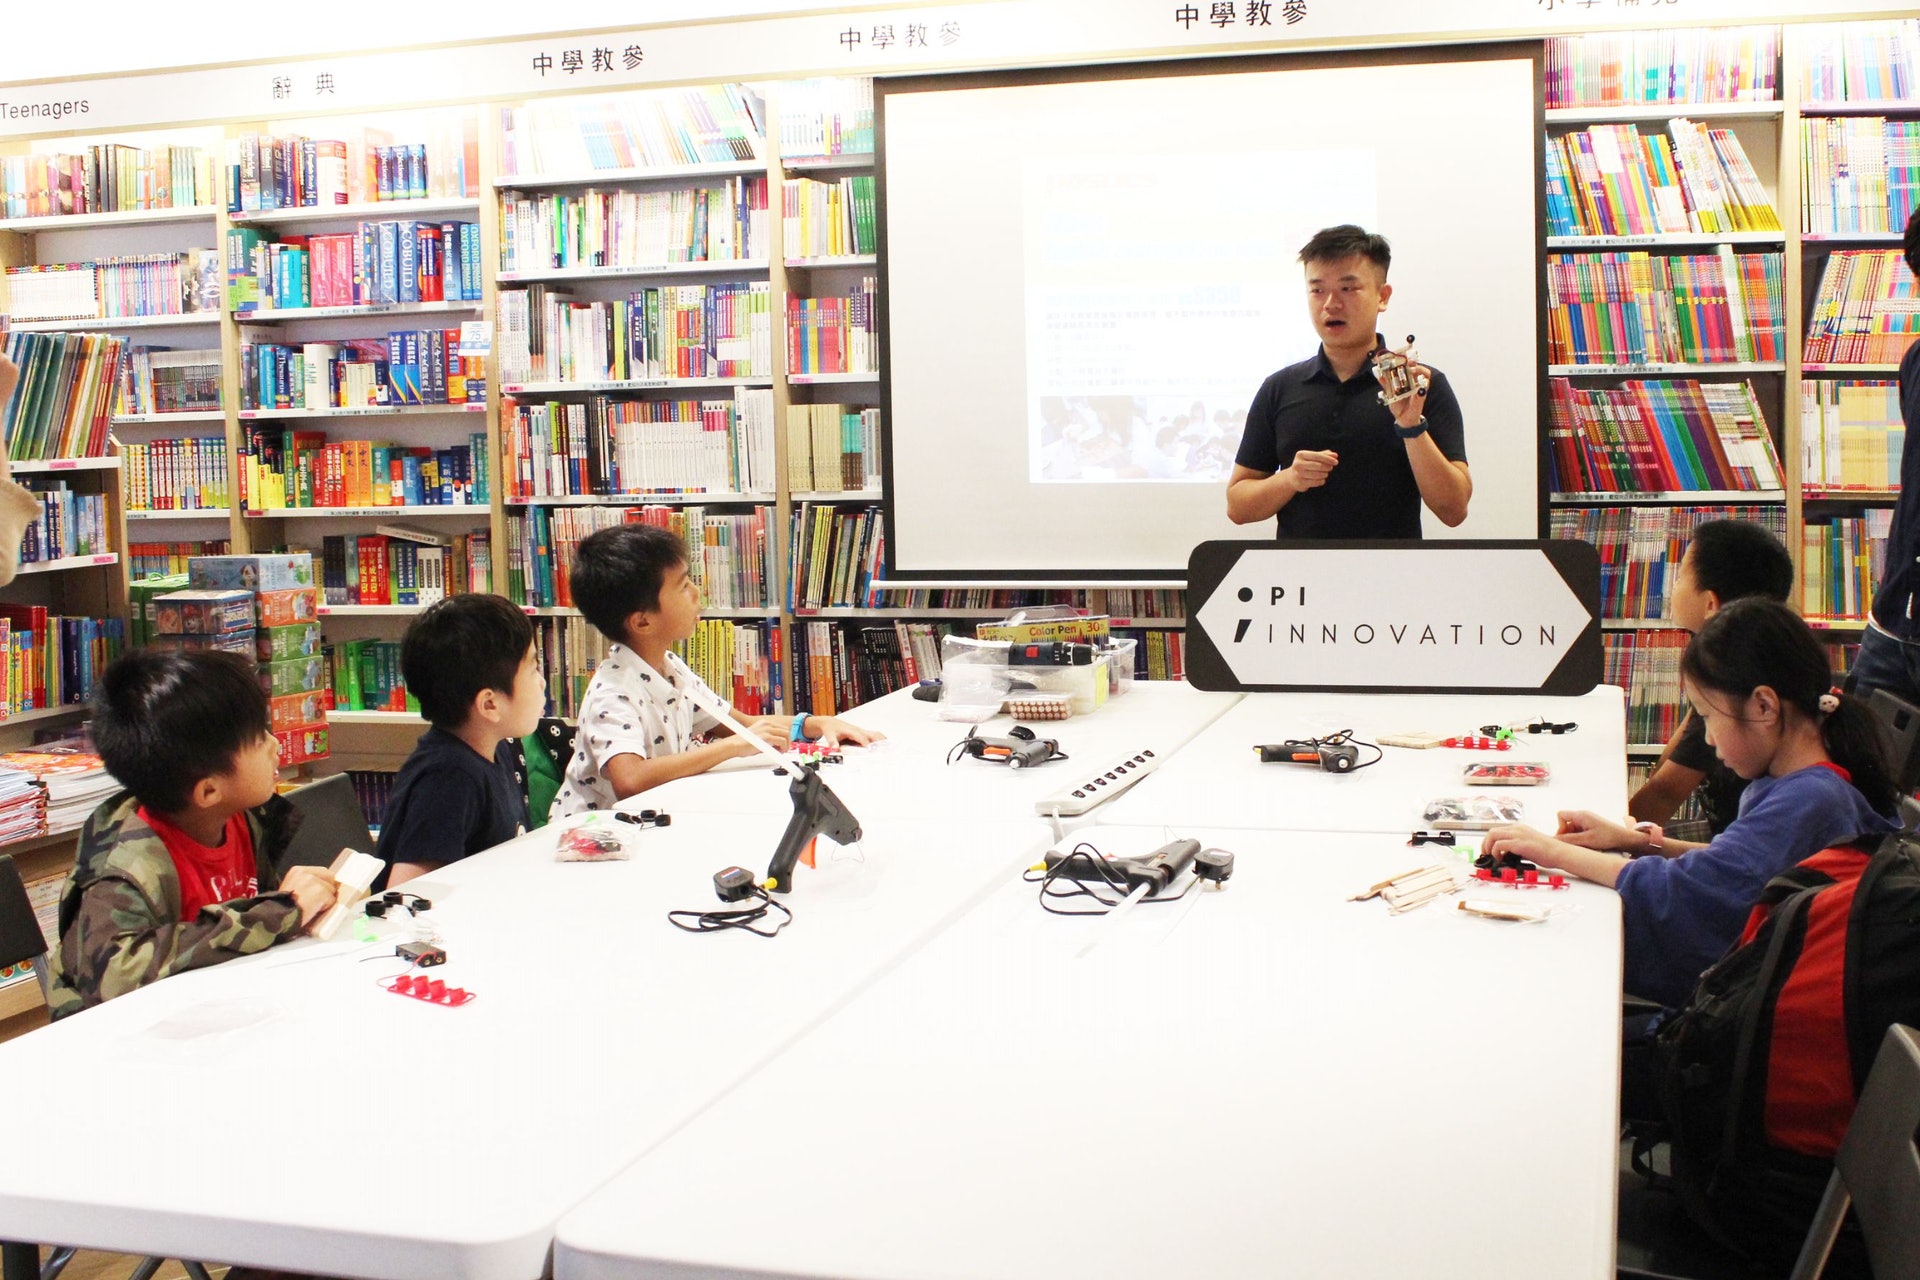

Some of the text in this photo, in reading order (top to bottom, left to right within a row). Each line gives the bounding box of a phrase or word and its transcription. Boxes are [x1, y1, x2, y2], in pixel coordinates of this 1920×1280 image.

[1176, 0, 1307, 30] 中學教參
[840, 20, 961, 52] 中學教參
[533, 45, 643, 77] 中學教參
[272, 71, 335, 100] 辭典
[1, 100, 90, 120] Teenagers
[381, 152, 389, 191] Dictionary
[397, 152, 405, 190] Dictionary
[412, 151, 420, 188] Dictionary
[382, 232, 393, 289] COBUILD
[402, 231, 413, 288] COBUILD
[461, 227, 470, 263] OXFORD
[471, 226, 480, 263] OXFORD
[279, 355, 287, 394] Thesaurus
[1271, 586, 1305, 606] PI
[1029, 621, 1100, 636] Color Pen 30
[1269, 623, 1555, 646] INNOVATION
